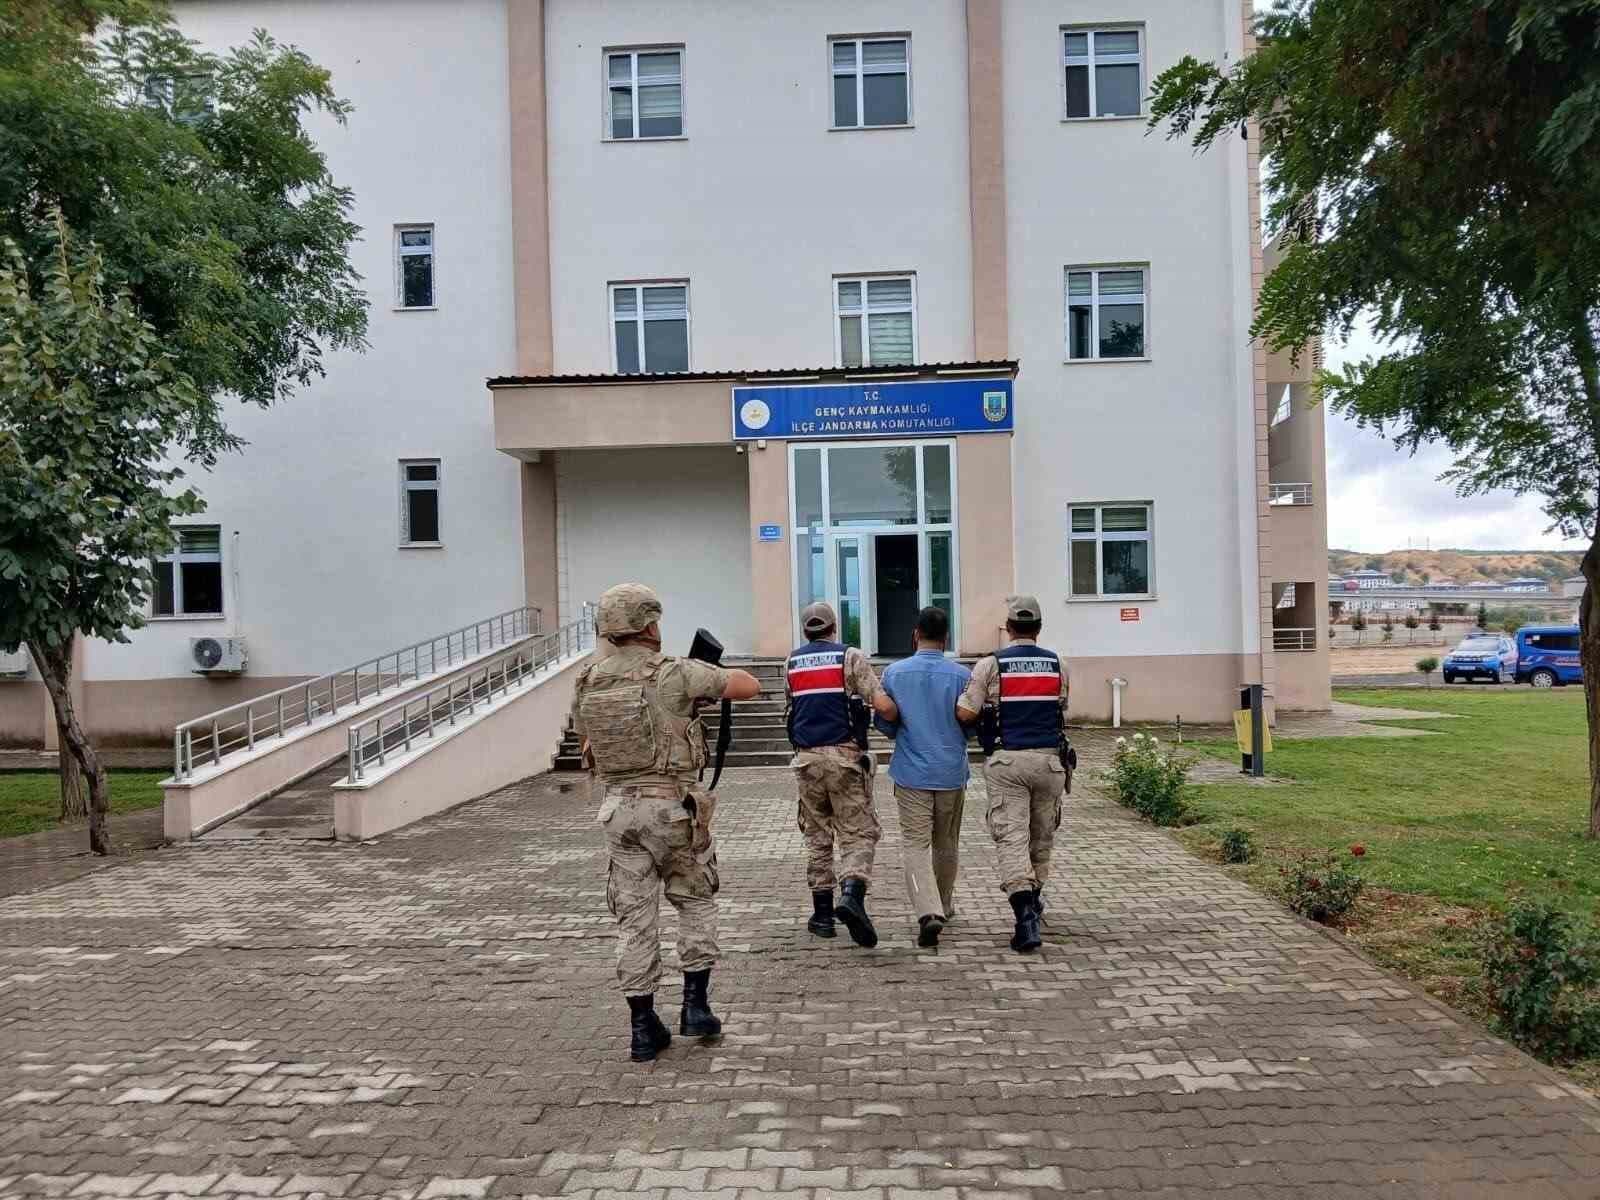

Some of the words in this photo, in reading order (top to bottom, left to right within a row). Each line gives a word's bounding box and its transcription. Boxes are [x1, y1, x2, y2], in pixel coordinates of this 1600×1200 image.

[815, 407, 846, 417] GENÇ
[791, 420, 816, 432] İLÇE
[819, 420, 878, 431] JANDARMA
[1006, 661, 1053, 672] JANDARMA
